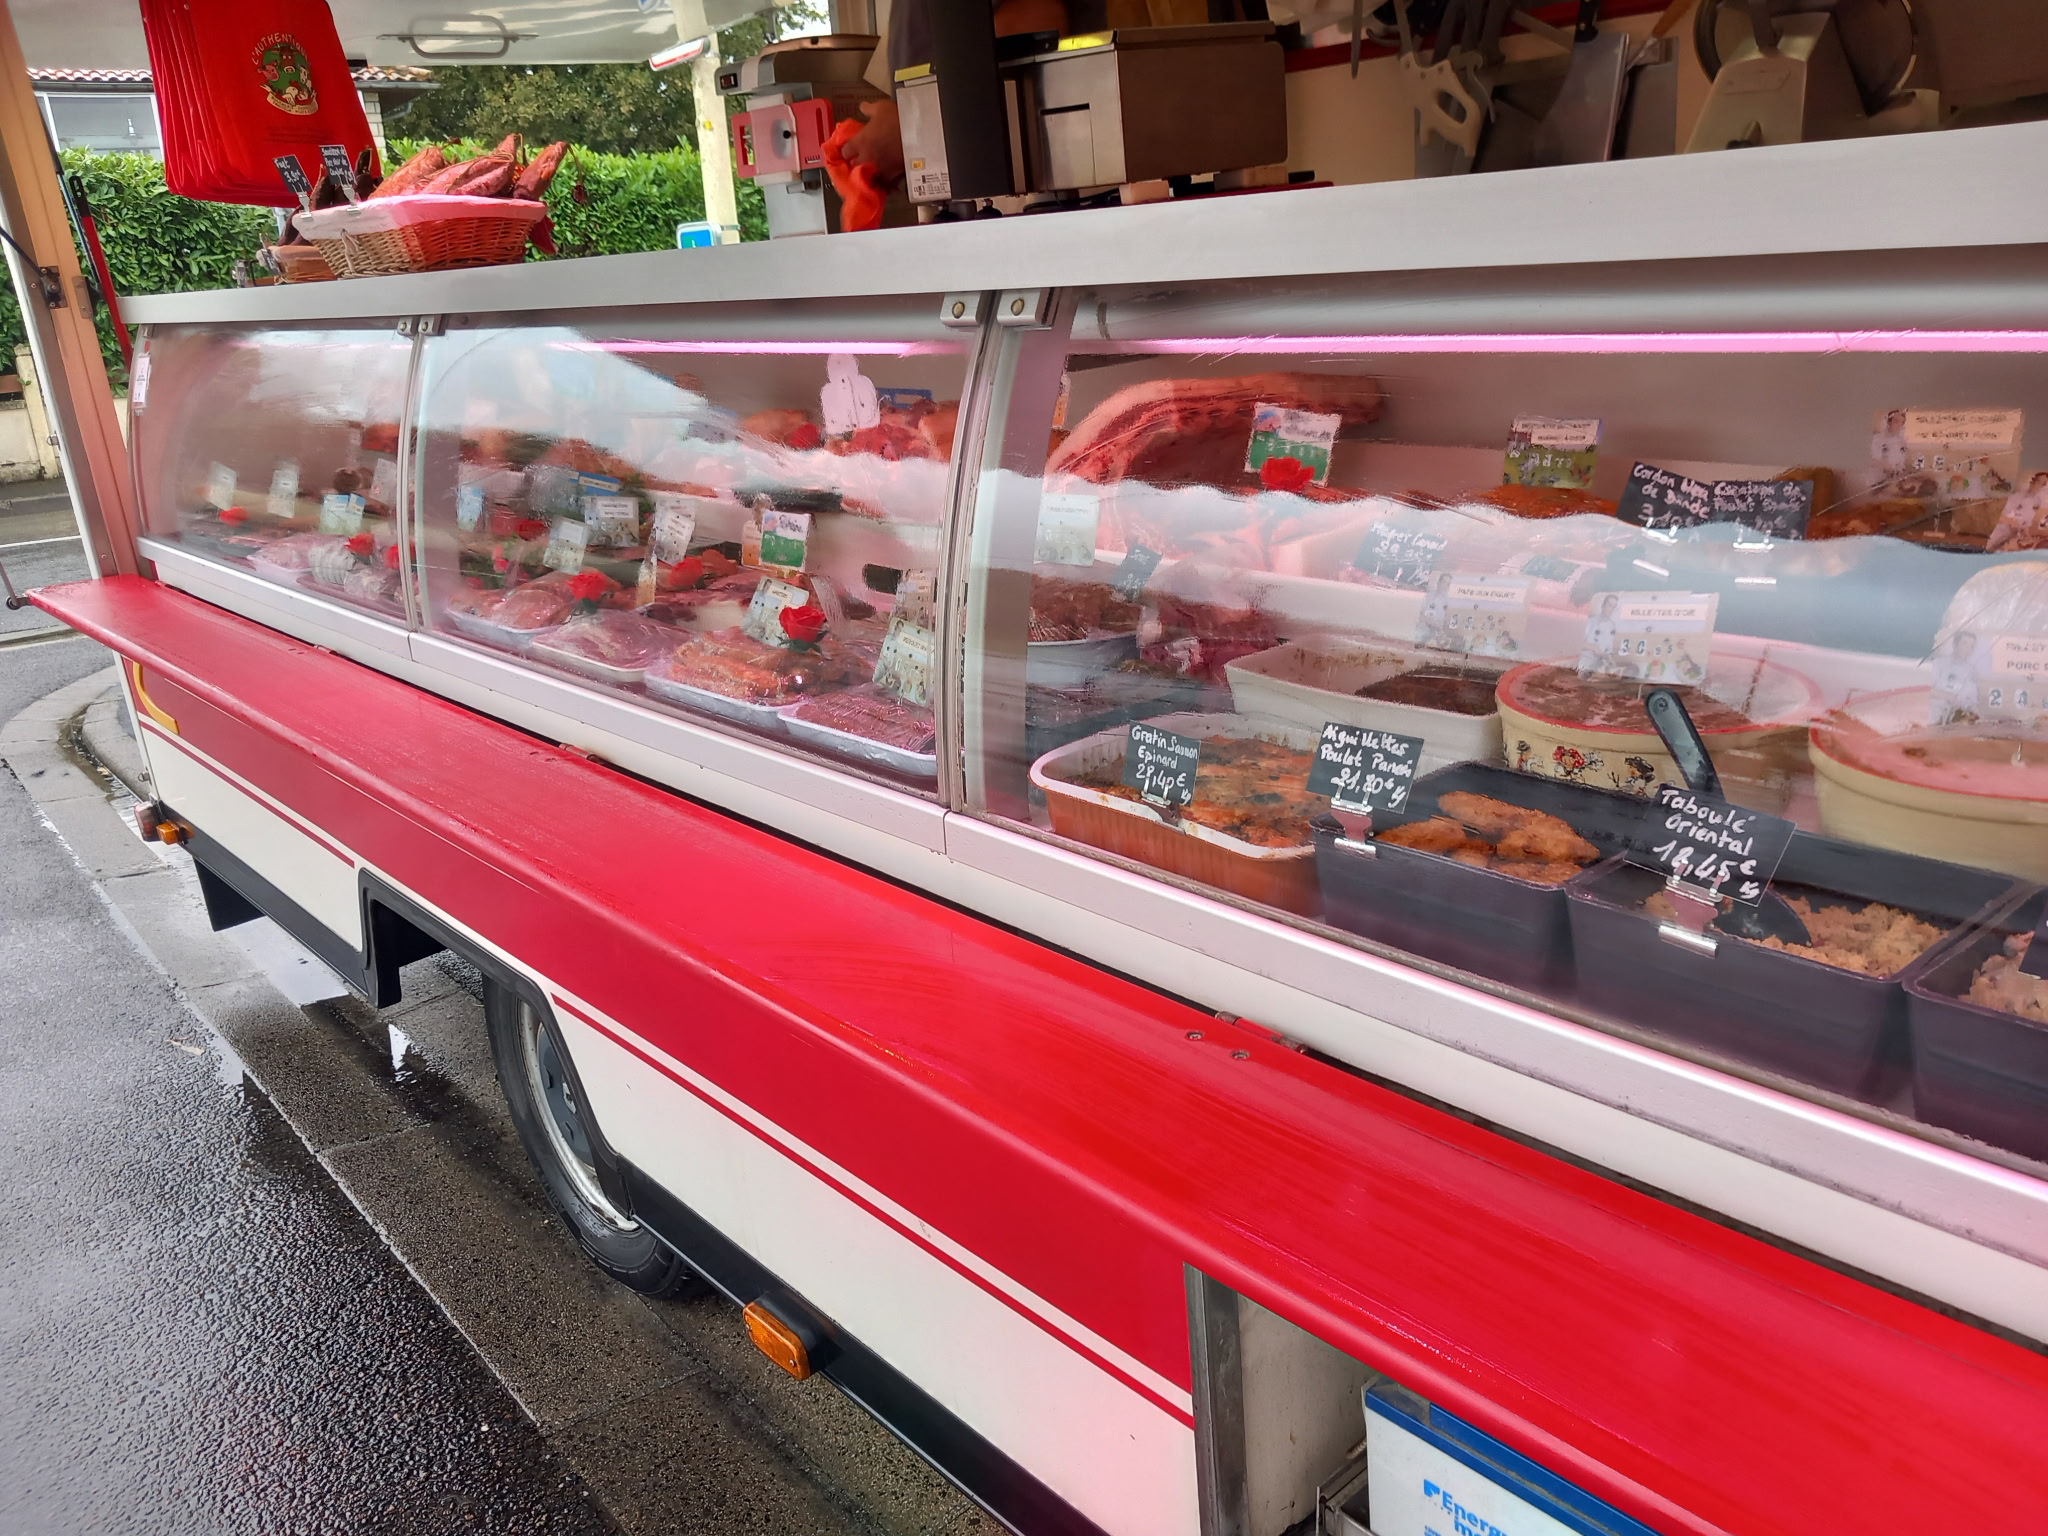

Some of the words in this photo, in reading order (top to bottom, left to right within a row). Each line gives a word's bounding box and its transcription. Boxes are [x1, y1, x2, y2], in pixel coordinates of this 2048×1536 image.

[2006, 660, 2041, 671] PORC
[1131, 724, 1168, 750] Gratin
[1137, 745, 1179, 769] Epinard
[1320, 743, 1363, 767] Poulet
[1661, 789, 1757, 834] Taboulé
[1664, 812, 1754, 856] Oriental
